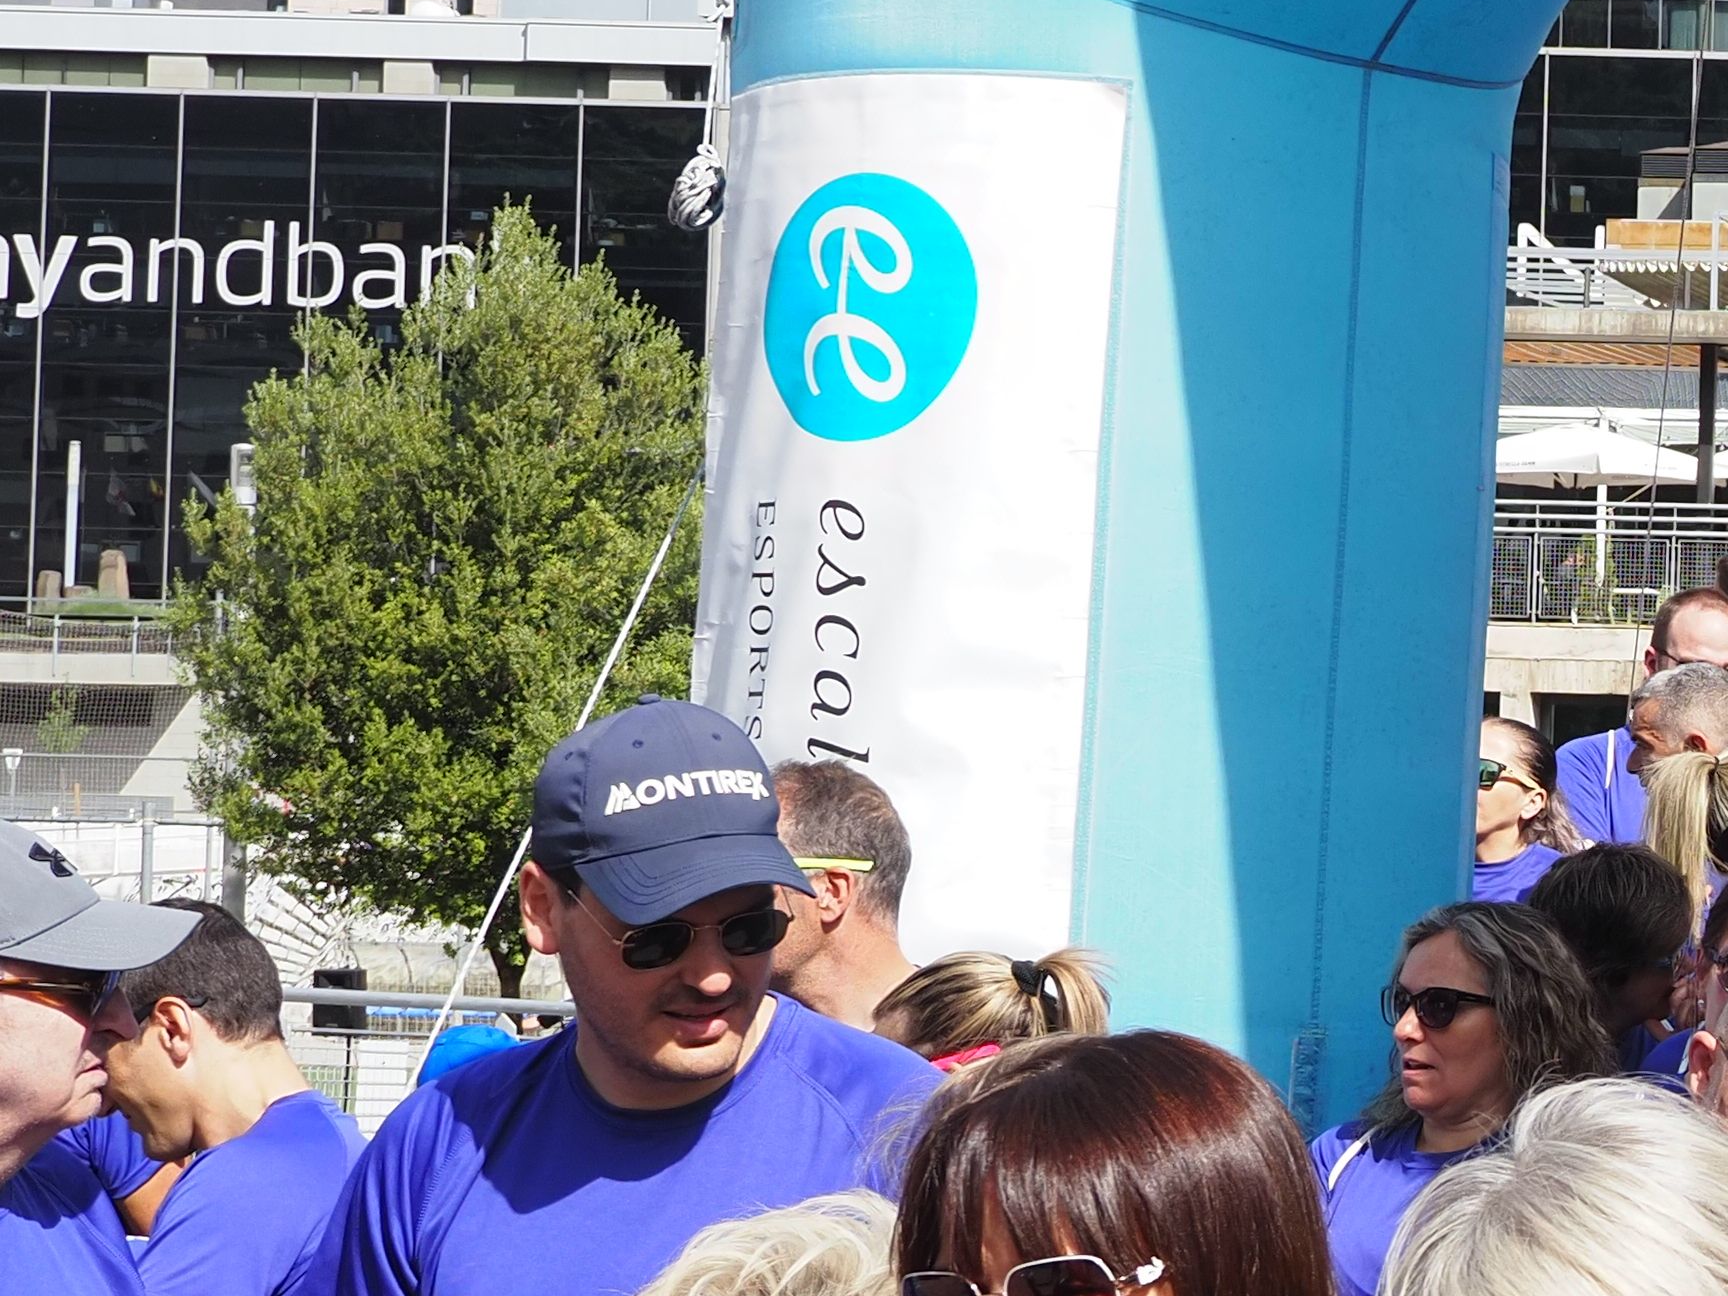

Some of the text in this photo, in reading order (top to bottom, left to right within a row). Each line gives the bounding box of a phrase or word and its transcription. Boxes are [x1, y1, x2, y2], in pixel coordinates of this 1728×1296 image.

[0, 220, 478, 318] yandban
[742, 498, 777, 741] ESPORTS
[605, 768, 770, 817] MONTIREX
